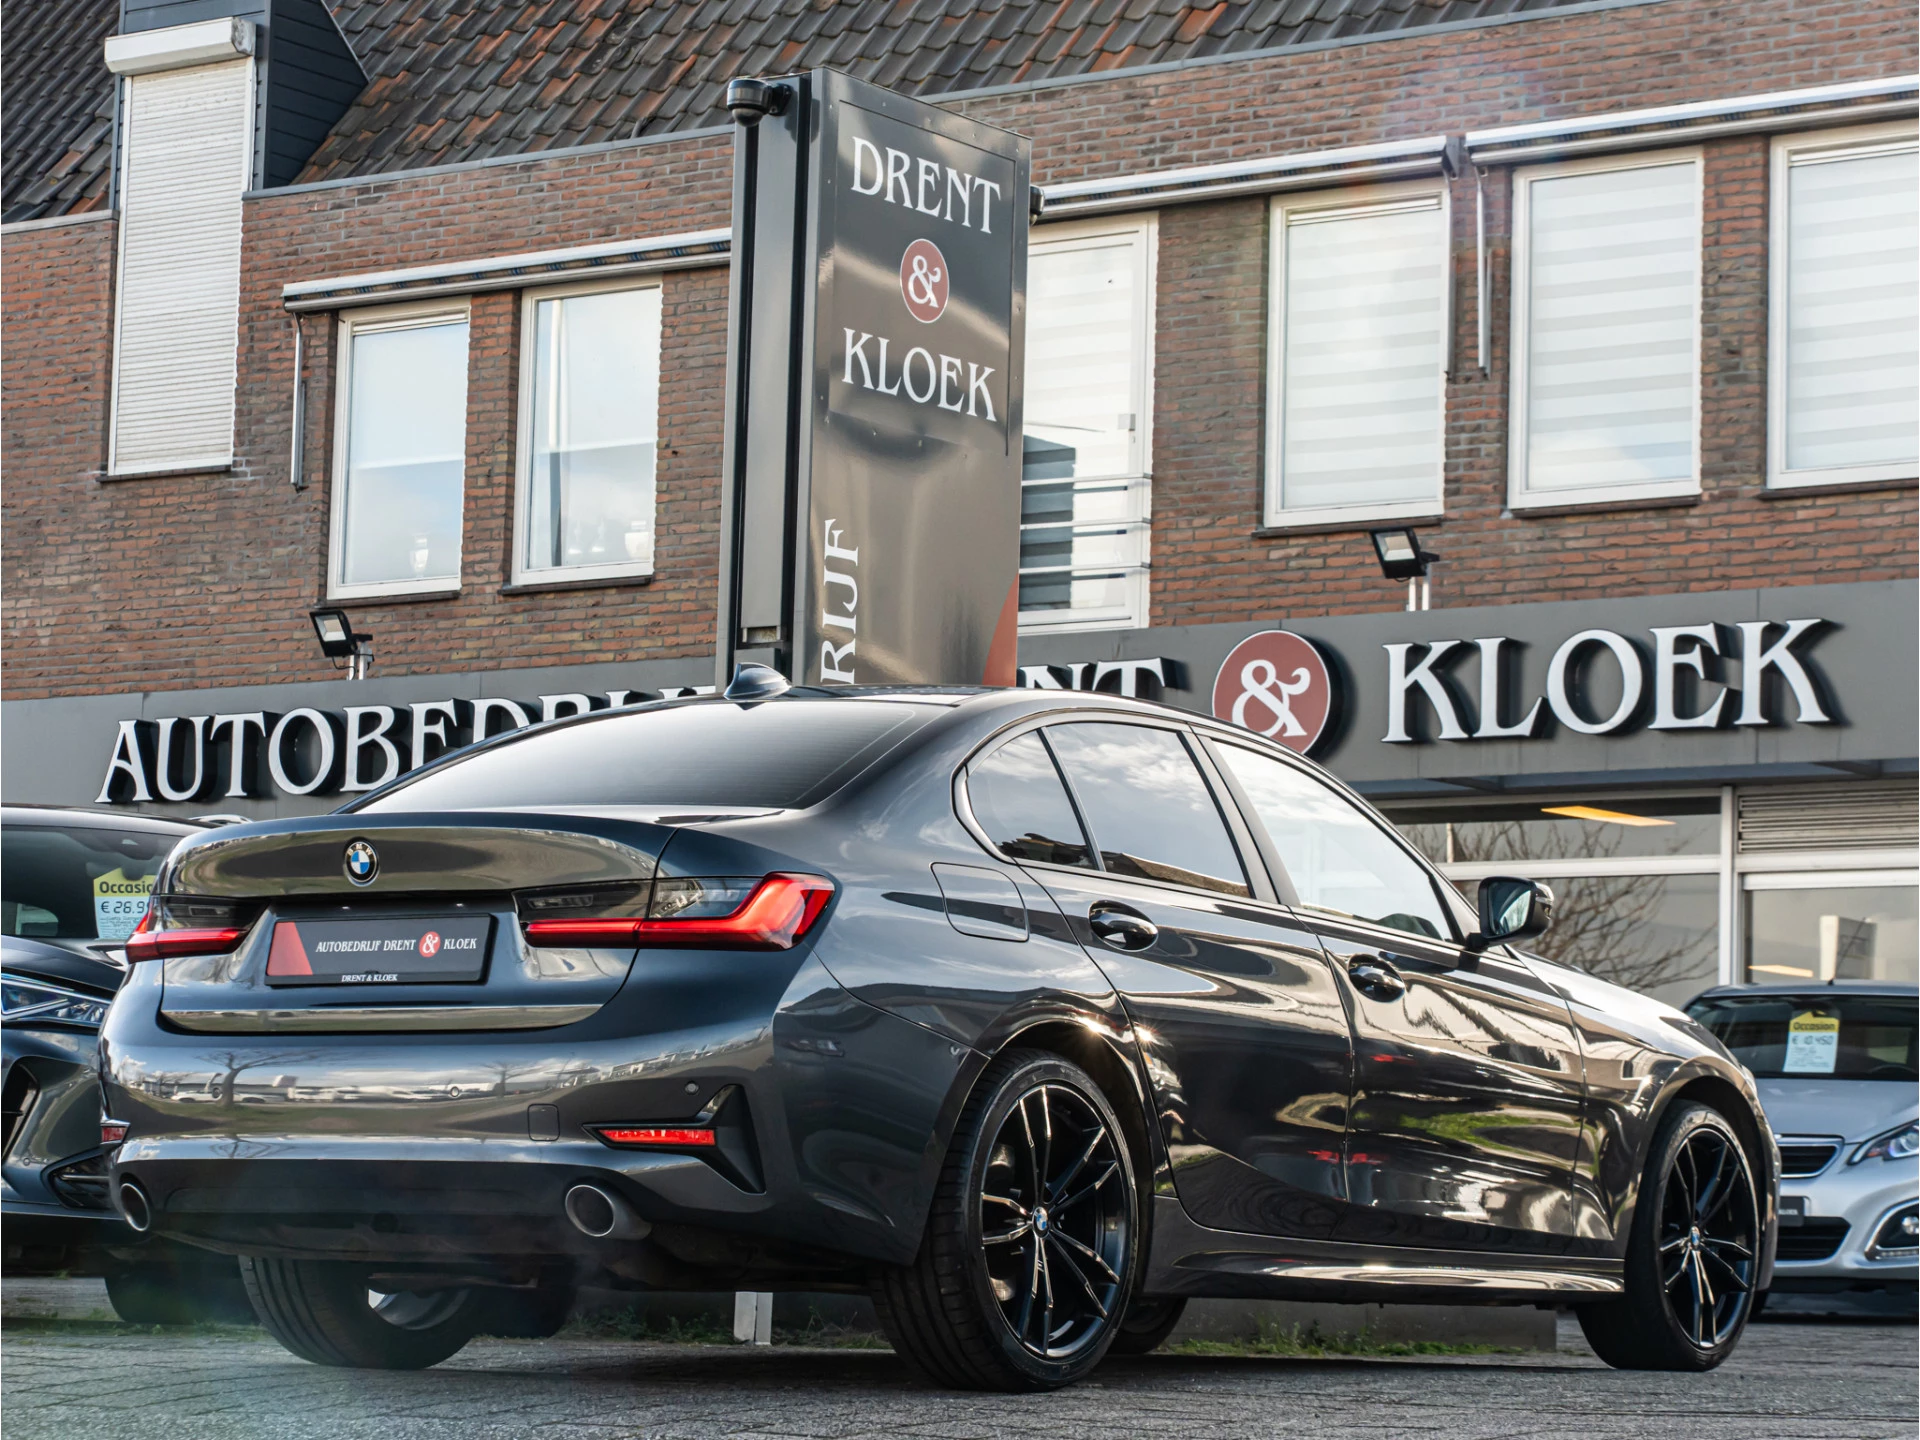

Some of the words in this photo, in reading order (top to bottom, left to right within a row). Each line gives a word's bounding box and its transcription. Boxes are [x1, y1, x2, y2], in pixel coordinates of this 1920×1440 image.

[850, 136, 1001, 235] DRENT
[908, 254, 942, 309] &
[841, 327, 997, 422] KLOEK
[820, 518, 859, 685] RIJF
[1231, 658, 1308, 738] &
[1381, 618, 1832, 743] KLOEK
[113, 901, 149, 914] 26.9
[315, 940, 381, 953] AUTOBEDRIJF
[383, 939, 417, 951] DRENT
[422, 933, 439, 954] &
[443, 938, 478, 950] KLOEK
[341, 974, 364, 982] DRENT
[373, 973, 398, 982] KLOEK
[1793, 1022, 1836, 1031] Occasion
